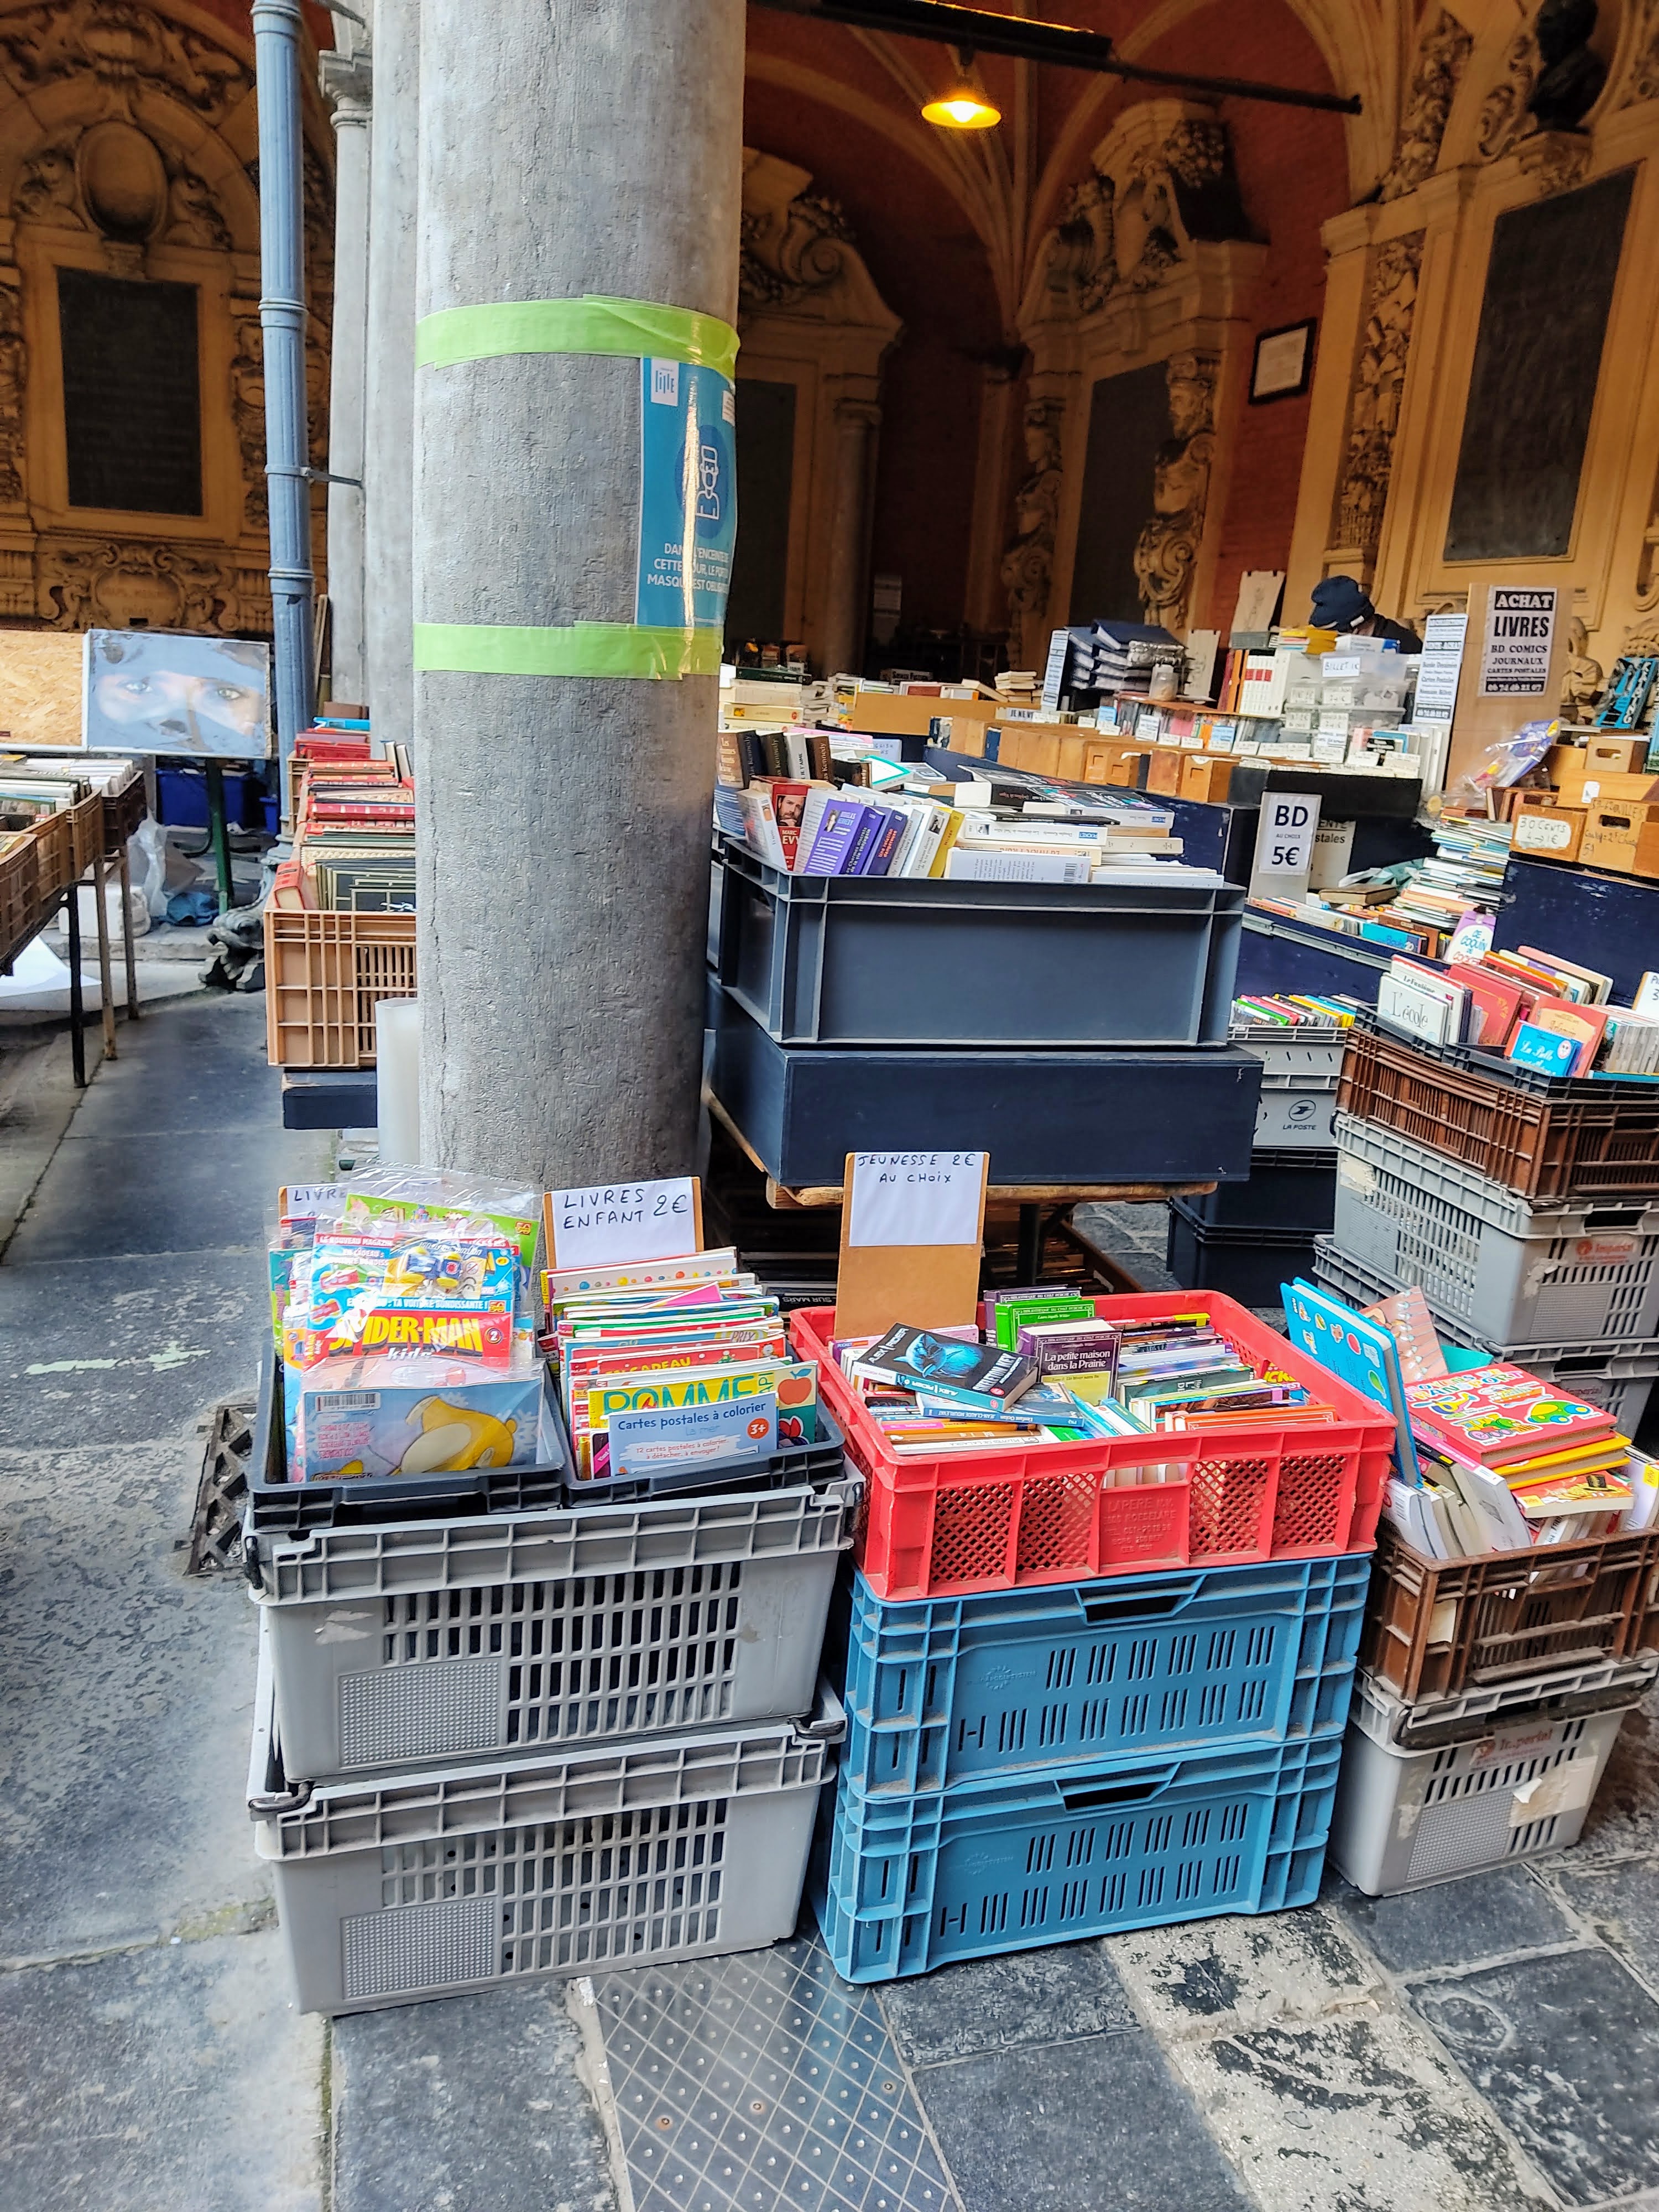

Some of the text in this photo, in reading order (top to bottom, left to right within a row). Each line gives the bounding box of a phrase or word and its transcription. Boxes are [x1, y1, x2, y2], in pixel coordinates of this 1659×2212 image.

[646, 573, 684, 588] MASQU
[1496, 594, 1552, 608] ACHAT
[1494, 616, 1550, 637] LIVRES
[1491, 645, 1548, 653] BD COMICS
[1275, 805, 1308, 827] BD
[1318, 819, 1348, 829] ENTE
[1520, 817, 1535, 830] 30
[1315, 833, 1345, 843] stales
[1272, 846, 1300, 866] 5€
[1391, 991, 1428, 1029] L'école
[858, 1153, 976, 1166] JEUNESSE 2€
[879, 1171, 951, 1183] AU CHOIX
[294, 1188, 347, 1202] LIVRE
[564, 1188, 645, 1209] LIVRES
[564, 1194, 688, 1229] ENFANT 2€
[328, 1315, 484, 1357] SIDER-MAN
[1044, 1350, 1110, 1363] La petite maison
[1047, 1359, 1107, 1371] dans la Prairie
[972, 1353, 1017, 1392] SKELETON KEY
[1405, 1370, 1524, 1402] TRANSPORT
[603, 1375, 756, 1416] POMME
[618, 1401, 767, 1431] Cartes postales à colorier
[750, 1423, 767, 1436] 3+
[667, 1443, 696, 1453] postales
